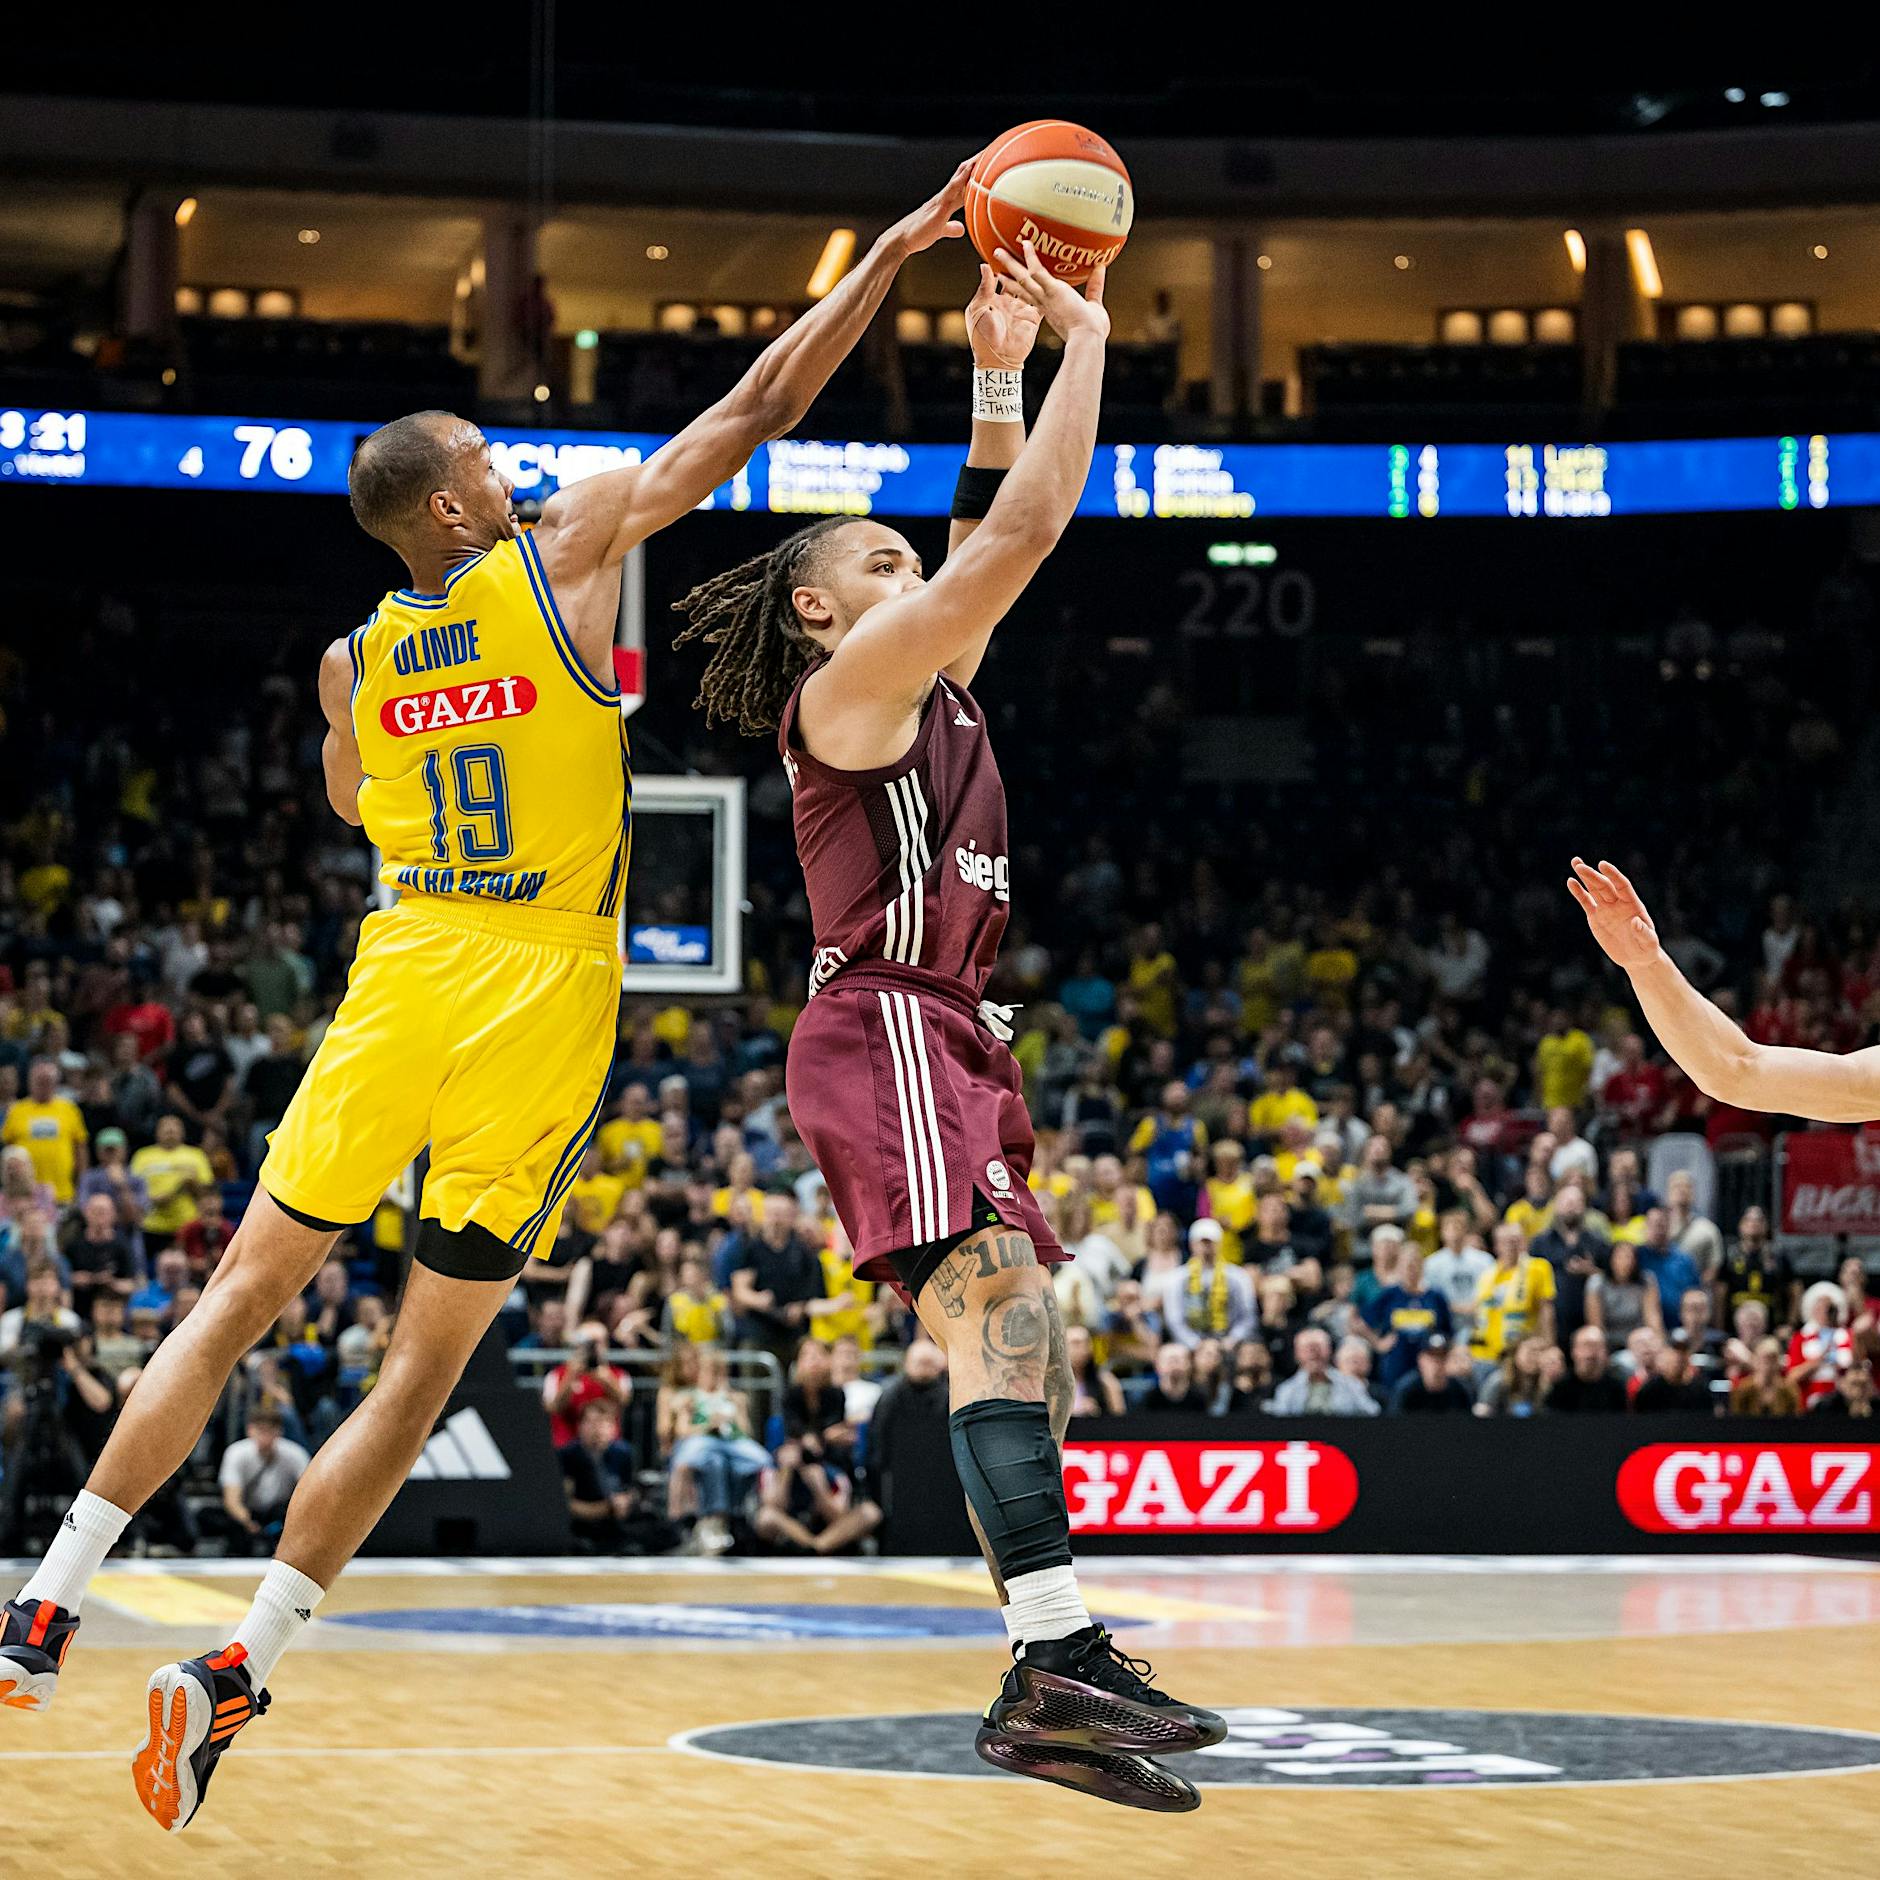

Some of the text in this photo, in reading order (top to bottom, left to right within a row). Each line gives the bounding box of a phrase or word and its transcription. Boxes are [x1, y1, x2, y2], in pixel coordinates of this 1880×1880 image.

[1016, 218, 1121, 267] SPALDING
[985, 370, 1021, 385] KILL
[233, 425, 313, 480] 76
[1177, 567, 1315, 637] 220
[393, 619, 481, 676] OLINDE
[421, 742, 514, 863] 19
